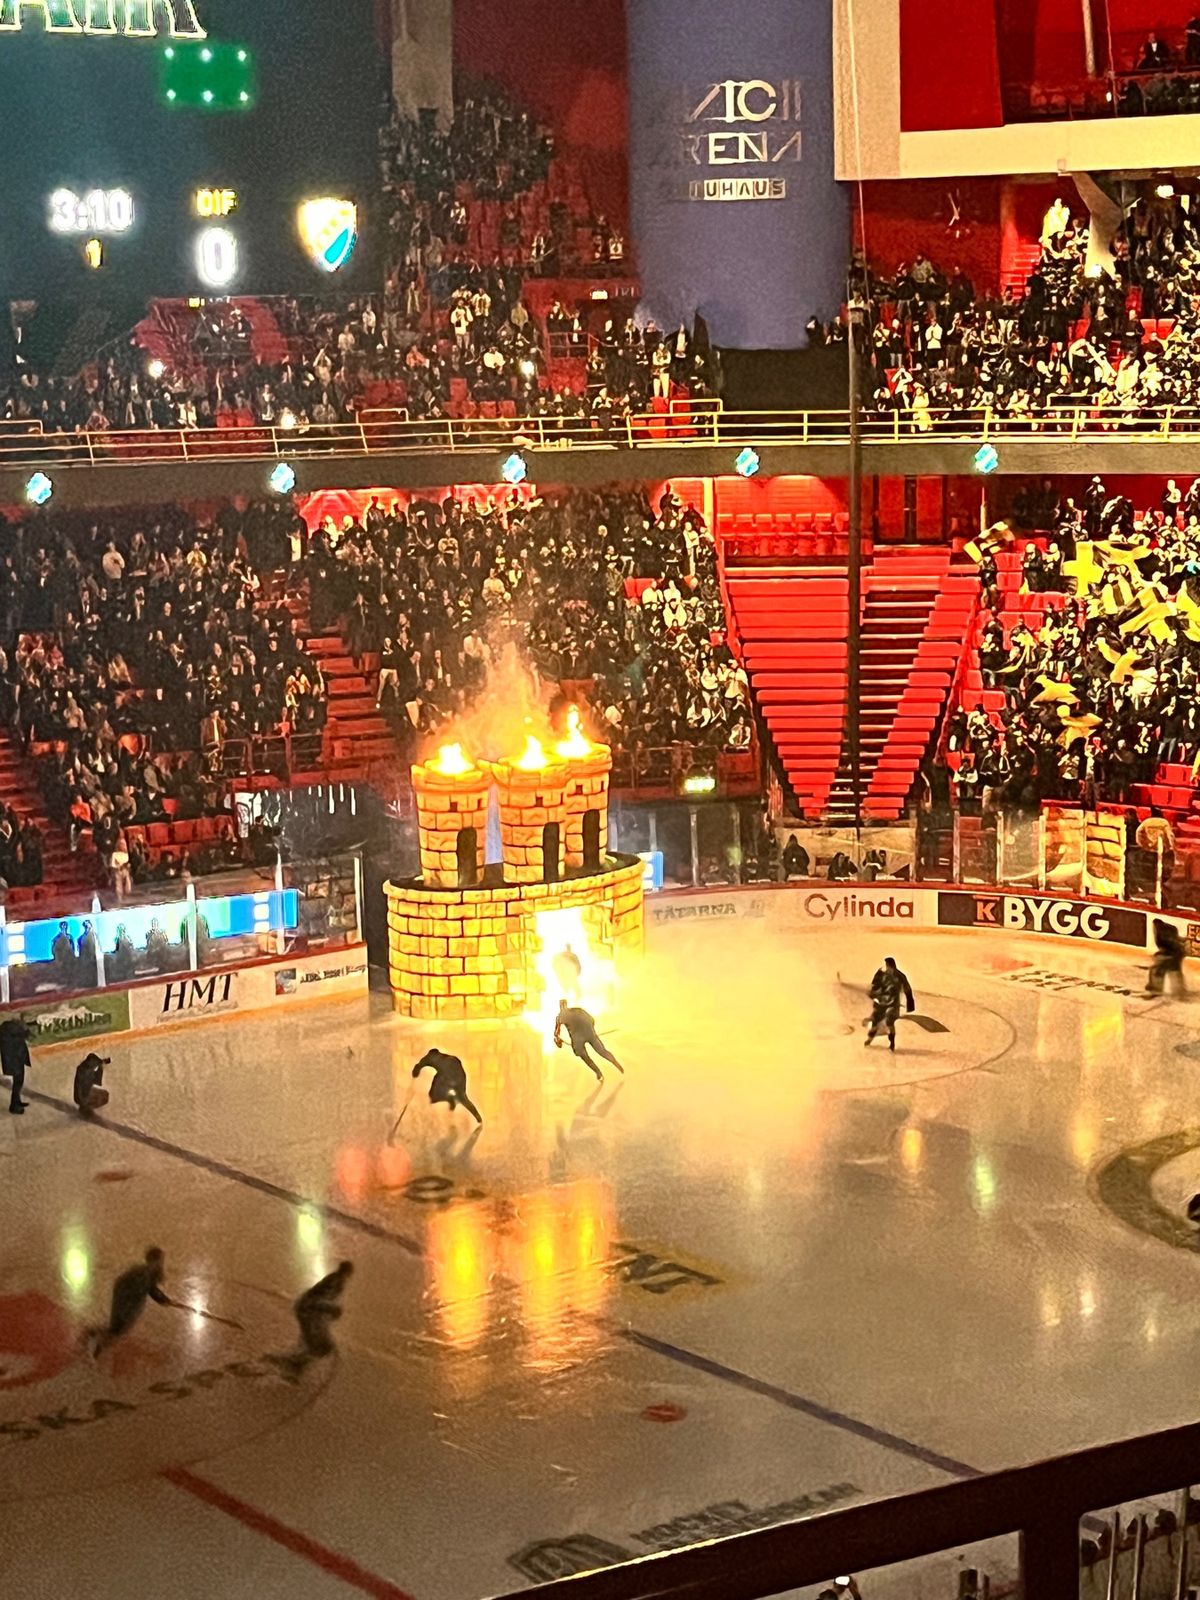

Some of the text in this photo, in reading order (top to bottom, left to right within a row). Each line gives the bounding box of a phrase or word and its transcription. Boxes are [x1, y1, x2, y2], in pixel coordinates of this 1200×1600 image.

[50, 187, 133, 232] 3:10
[196, 227, 238, 287] 0
[804, 893, 914, 921] Cylinda
[1003, 896, 1110, 939] BYGG
[161, 972, 238, 1014] HMT
